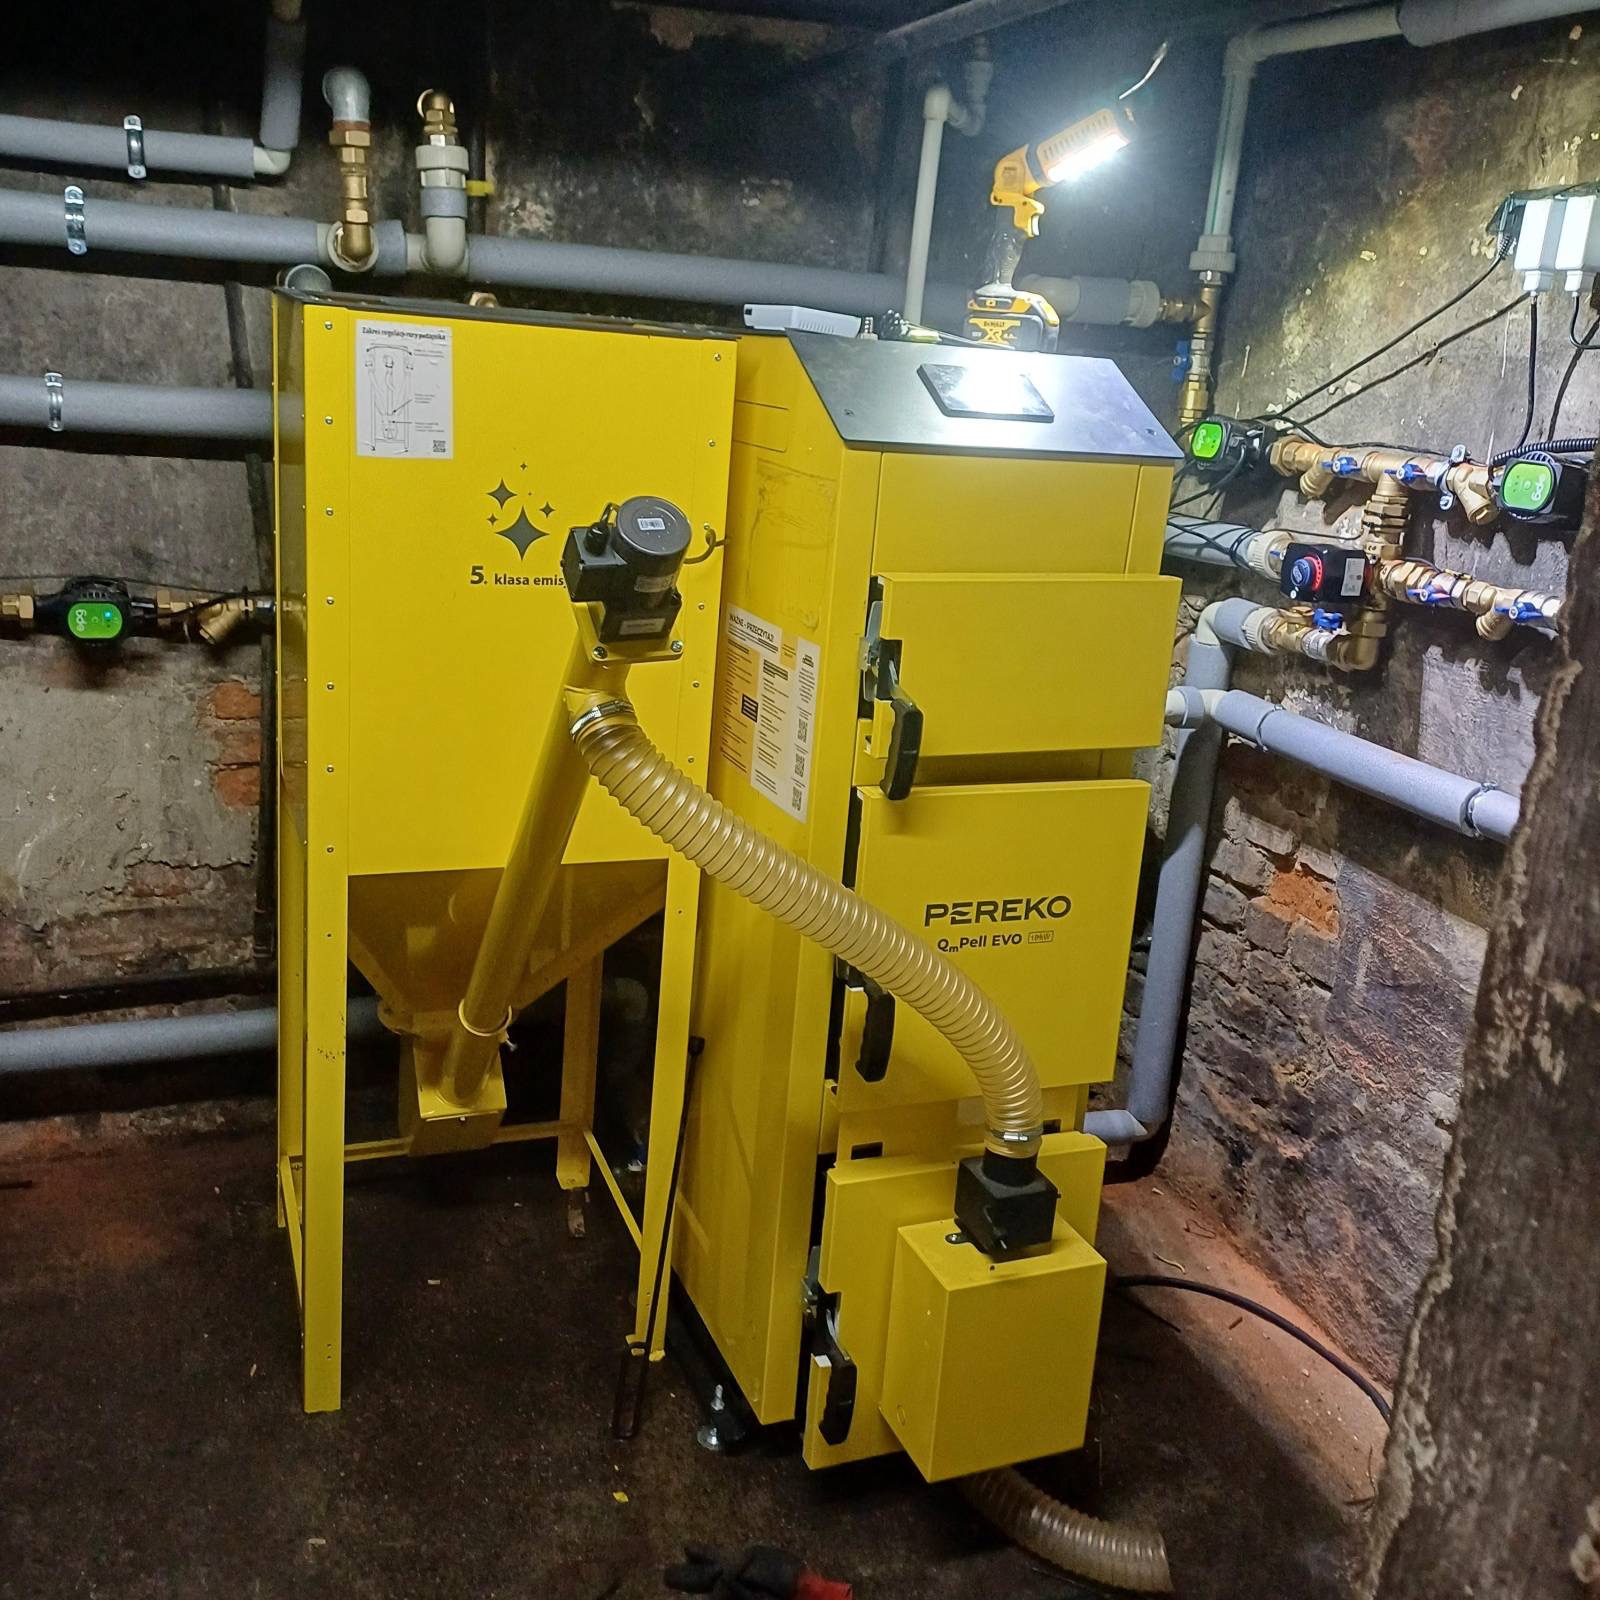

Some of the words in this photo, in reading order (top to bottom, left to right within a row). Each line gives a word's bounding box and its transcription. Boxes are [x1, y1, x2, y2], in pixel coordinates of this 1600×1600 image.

[470, 565, 488, 585] 5.
[494, 573, 530, 586] klasa
[924, 895, 1072, 927] PEREKO
[991, 933, 1023, 947] EVO
